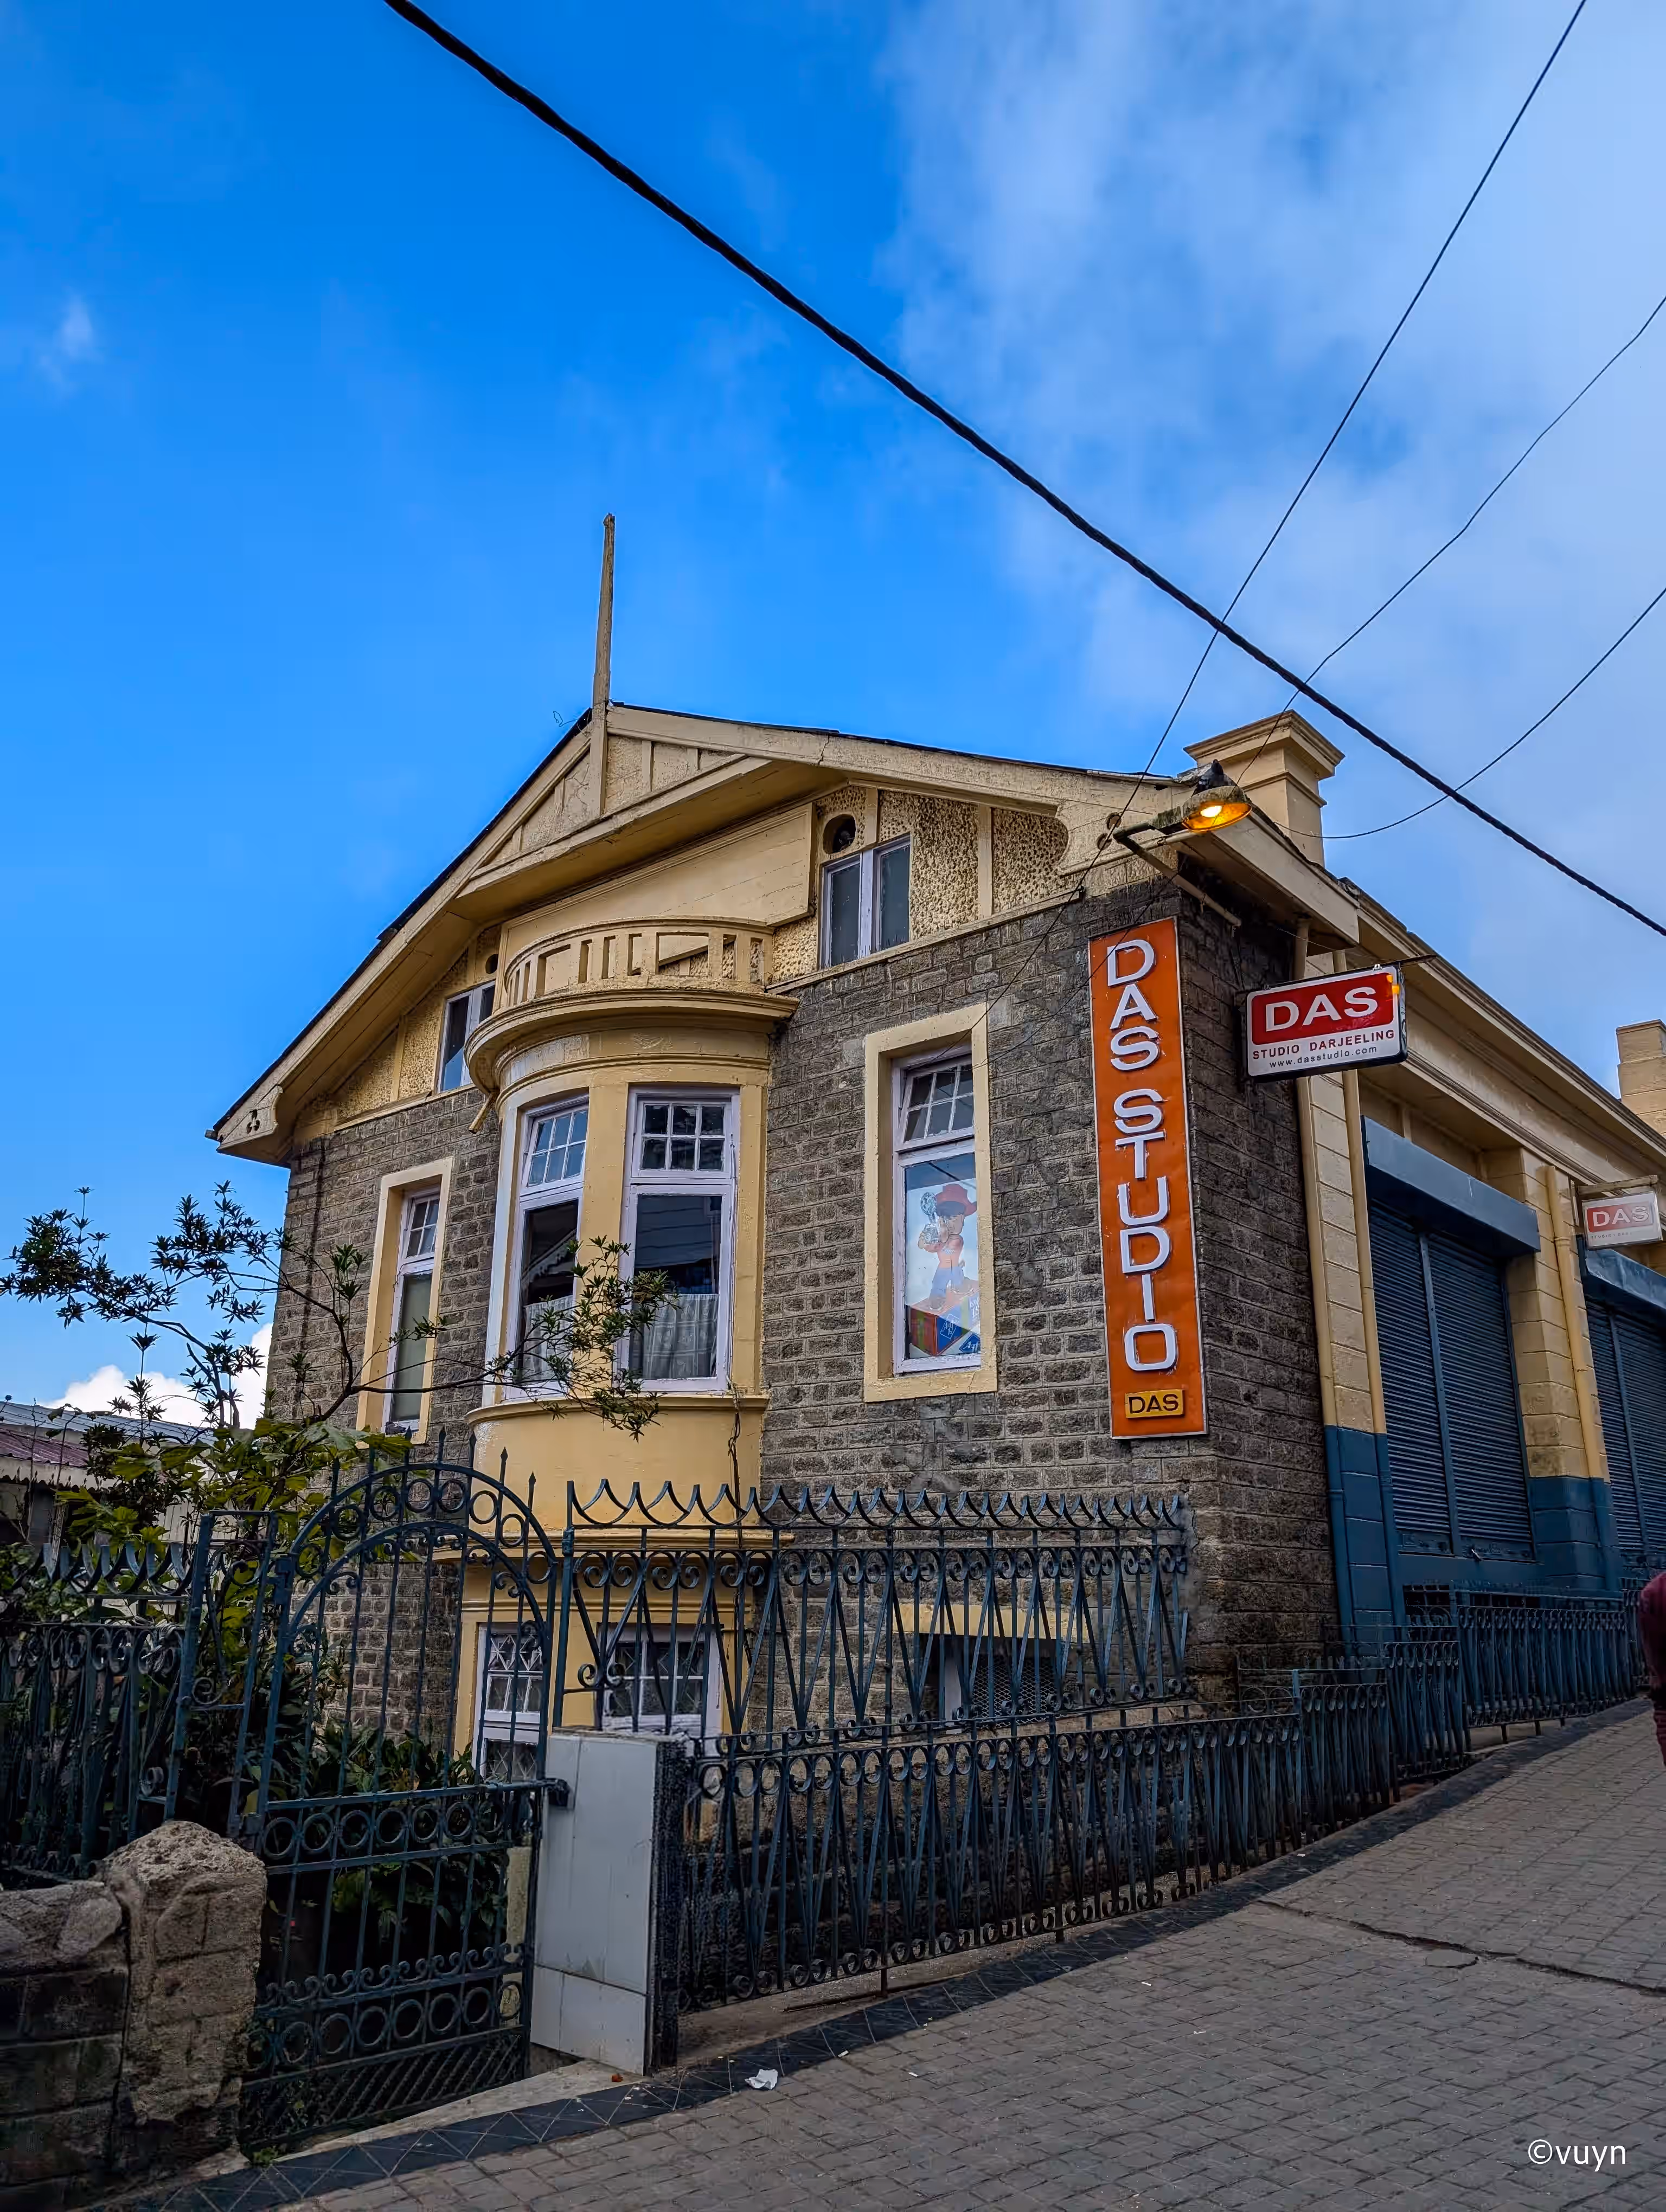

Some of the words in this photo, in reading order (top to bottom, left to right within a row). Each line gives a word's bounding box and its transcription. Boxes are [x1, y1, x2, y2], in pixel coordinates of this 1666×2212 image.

[1107, 938, 1159, 1071] DAS
[1265, 986, 1379, 1032] DAS
[1252, 1044, 1300, 1060] STUDIO
[1309, 1029, 1395, 1052] DARJEELING
[1269, 1045, 1377, 1068] www.dasstudio.com
[1113, 1088, 1178, 1372] STUDIO
[1592, 1205, 1650, 1227] DAS
[1128, 1393, 1178, 1414] DAS
